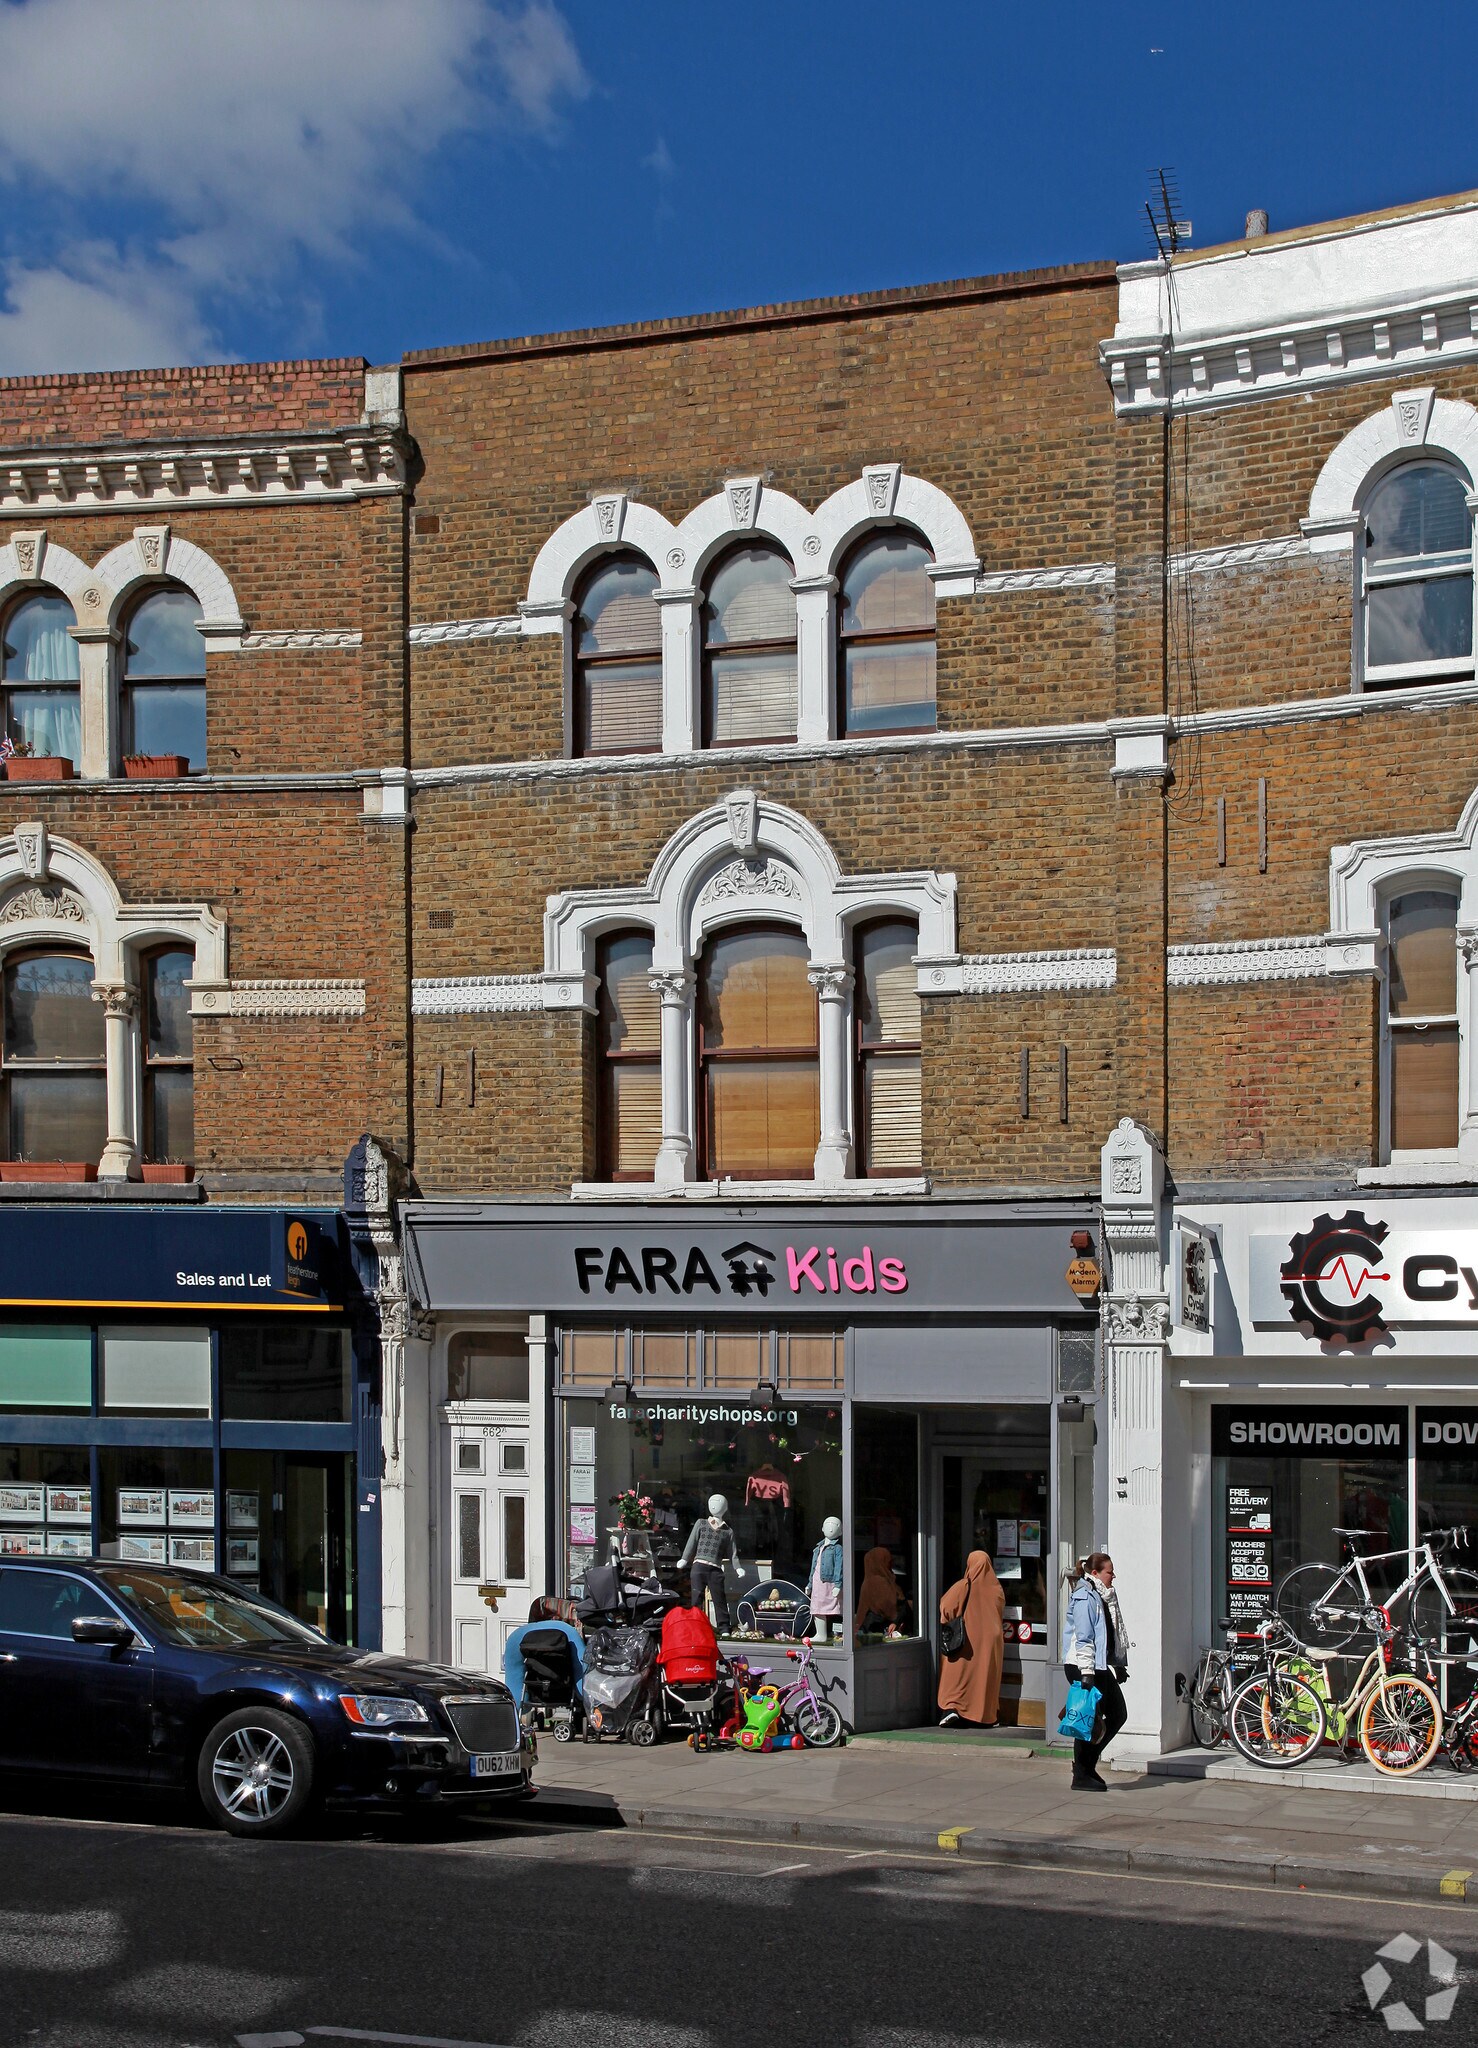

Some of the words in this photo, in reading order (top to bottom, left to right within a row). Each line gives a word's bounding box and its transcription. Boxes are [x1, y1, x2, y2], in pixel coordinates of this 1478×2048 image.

[287, 1263, 319, 1280] featherstone
[574, 1247, 721, 1294] FARA
[786, 1246, 908, 1294] Kids
[176, 1272, 215, 1286] Sales
[218, 1273, 245, 1287] and
[249, 1273, 271, 1287] Let
[1187, 1295, 1204, 1311] Cycle
[1183, 1306, 1208, 1328] Surgery
[609, 1403, 798, 1426] faracharityshops.org
[1230, 1422, 1400, 1445] SHOWROOM
[1229, 1488, 1250, 1496] FREE
[1229, 1496, 1269, 1505] DELIVERY
[477, 1756, 503, 1773] OU62
[504, 1755, 520, 1771] XHW
